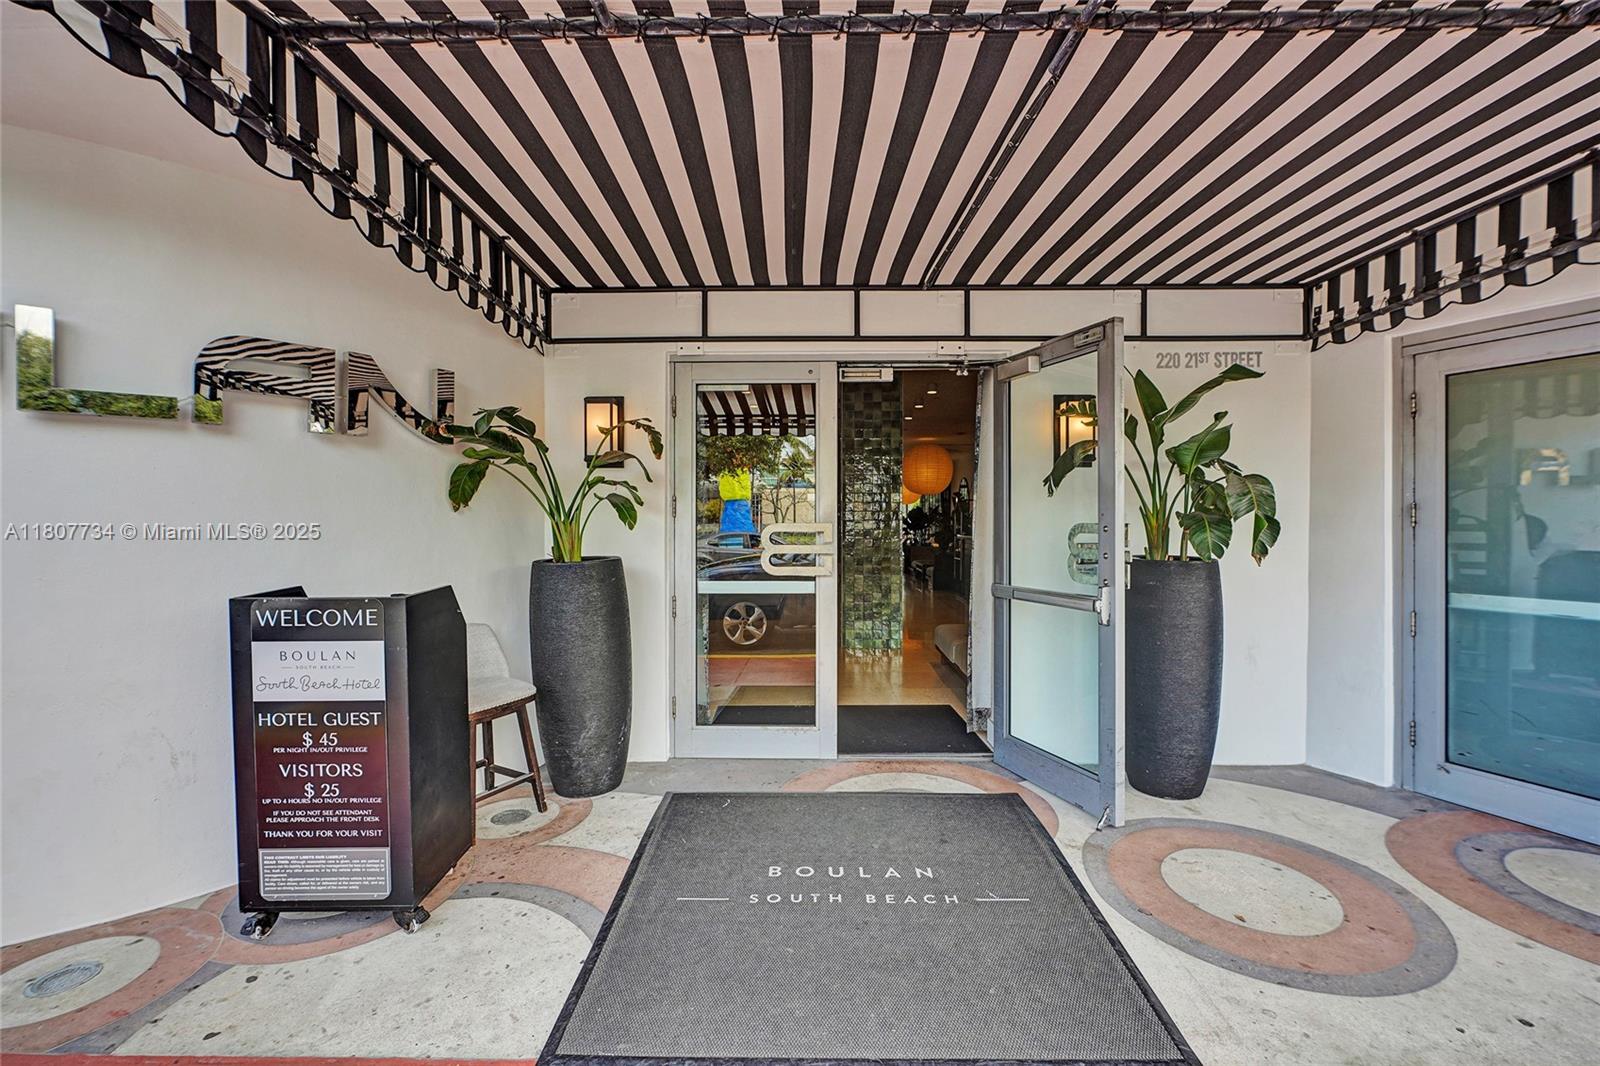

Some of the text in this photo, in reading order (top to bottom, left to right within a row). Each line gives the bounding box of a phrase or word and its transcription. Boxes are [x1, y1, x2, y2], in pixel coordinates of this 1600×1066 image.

[1156, 352, 1181, 369] 220
[1213, 351, 1263, 369] STREET
[255, 609, 378, 627] WELCOME
[279, 650, 357, 662] BOULAN
[256, 675, 298, 692] South
[342, 677, 381, 690] Hotel
[257, 711, 382, 727] HOTEL GUEST
[302, 731, 338, 748] $ 45
[279, 763, 364, 778] VISITORS
[303, 782, 340, 798] $ 25
[264, 829, 383, 838] THANK YOU FOR YOUR VISIT
[767, 865, 937, 879] BOULAN
[749, 893, 960, 905] SOUTH BEACH
